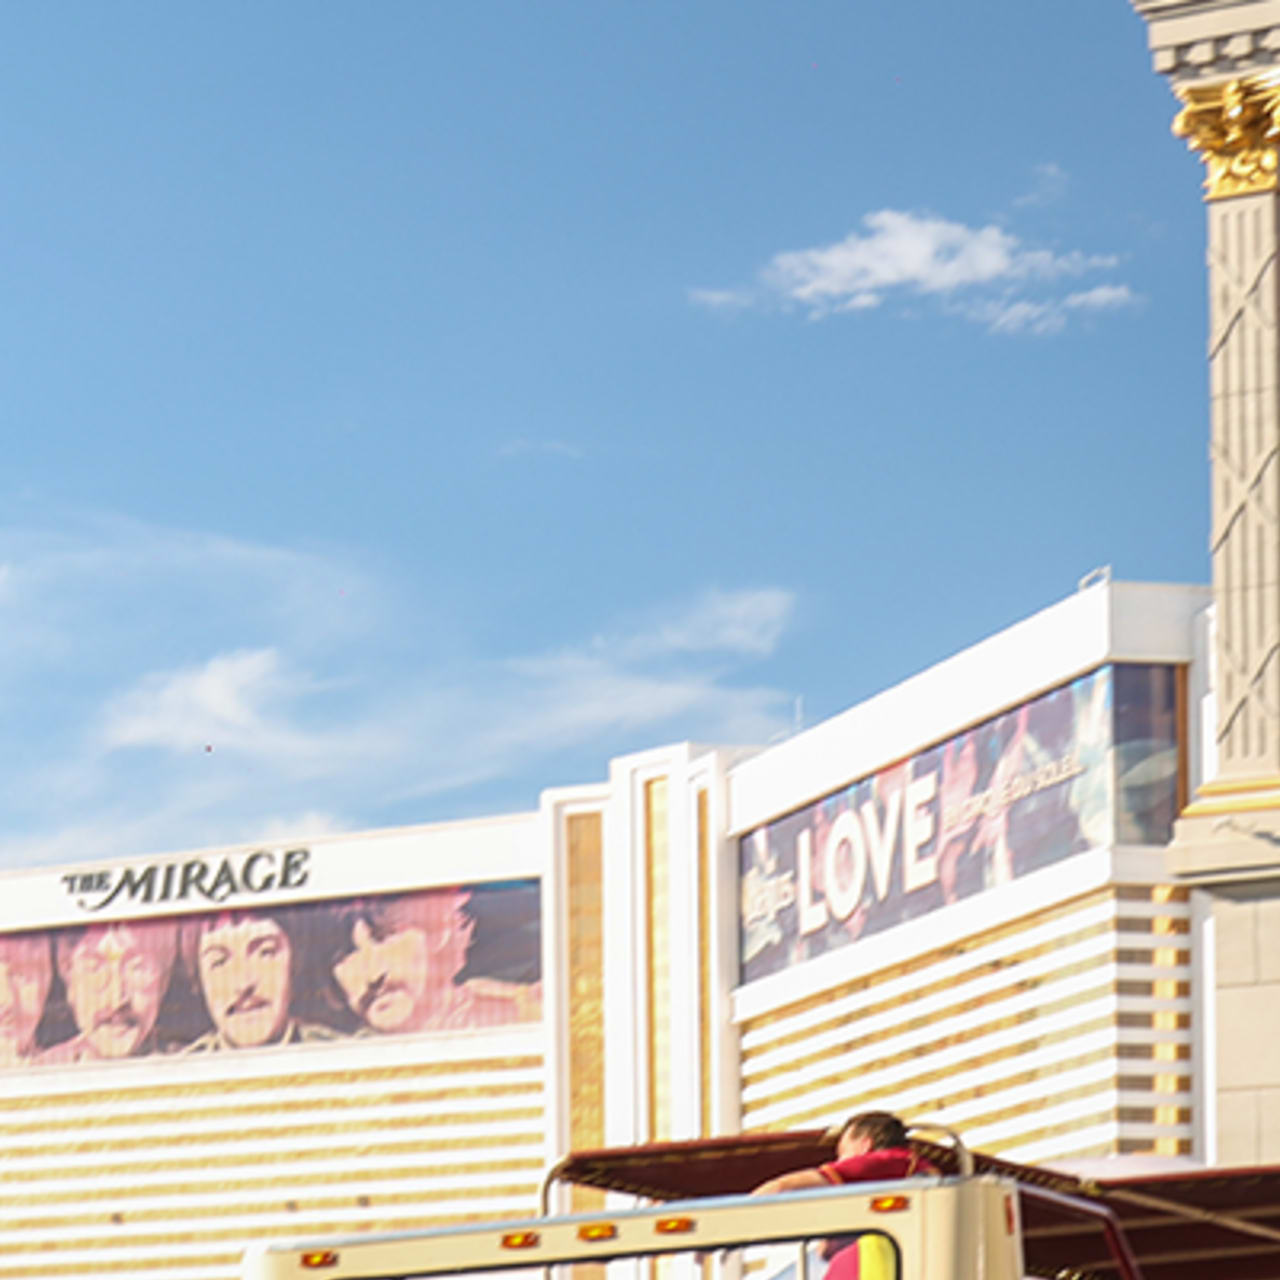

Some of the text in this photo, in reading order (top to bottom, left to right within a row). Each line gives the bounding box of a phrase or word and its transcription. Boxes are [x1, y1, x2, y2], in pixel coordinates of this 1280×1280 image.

[60, 849, 310, 911] THE MIRAGE
[796, 770, 940, 937] LOVE
